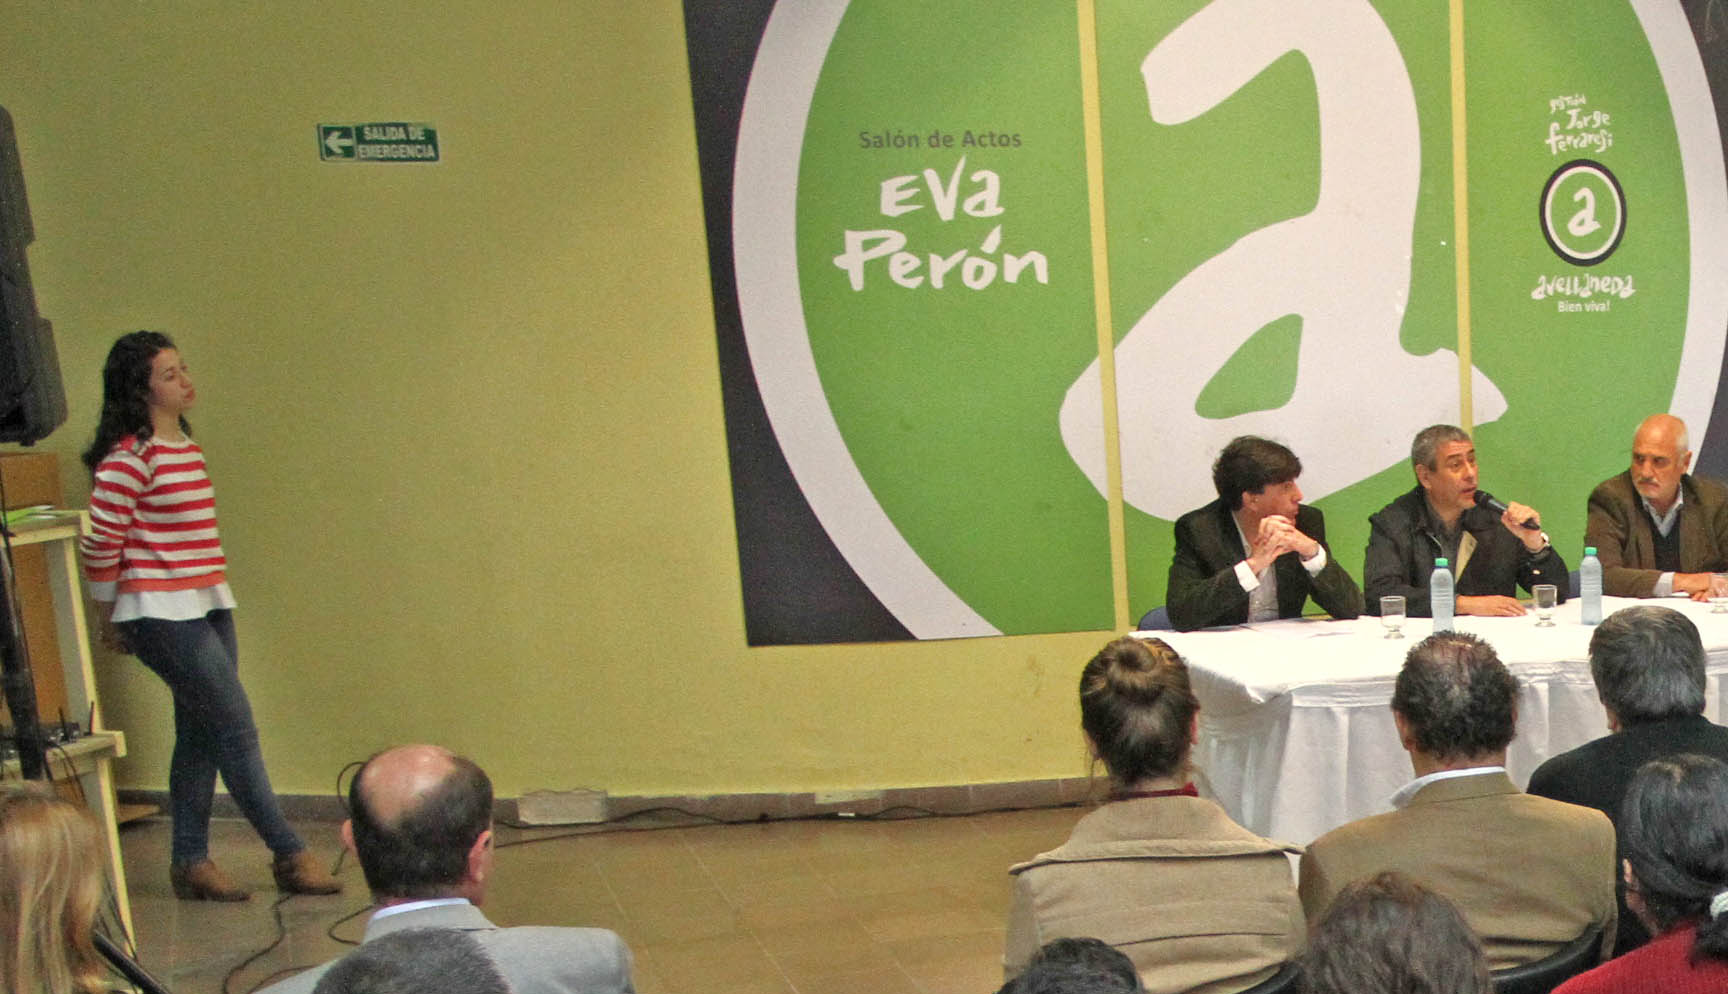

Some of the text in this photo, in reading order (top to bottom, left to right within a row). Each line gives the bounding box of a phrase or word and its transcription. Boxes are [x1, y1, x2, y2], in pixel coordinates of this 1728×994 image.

[1566, 108, 1611, 130] Jorge
[363, 126, 426, 140] SALIDA DE
[859, 130, 1022, 148] Salón de Actos
[359, 144, 435, 159] EMERGENCIA
[1567, 187, 1601, 237] a
[833, 224, 1049, 292] Perón
[1558, 300, 1610, 313] Bien viva!
